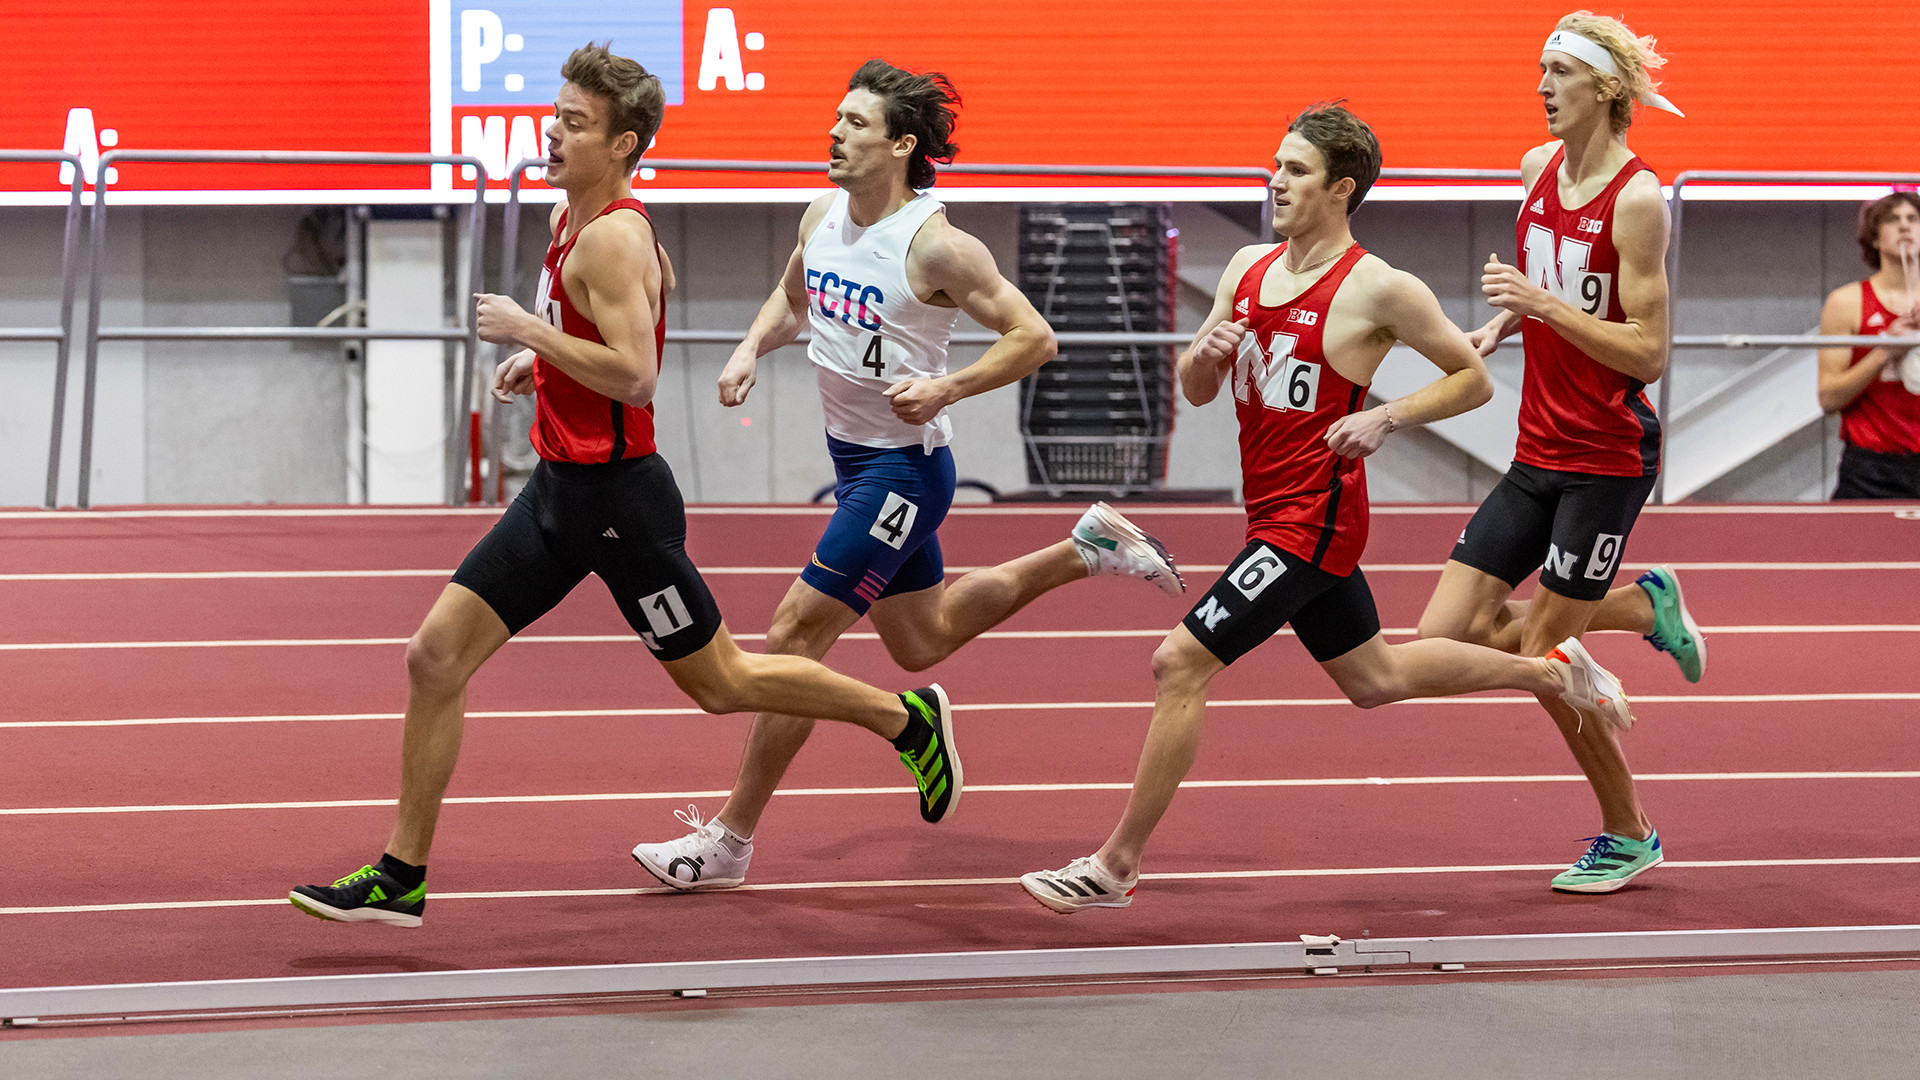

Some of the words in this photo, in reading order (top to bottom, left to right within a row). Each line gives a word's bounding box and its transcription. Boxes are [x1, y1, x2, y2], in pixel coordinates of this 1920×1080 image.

[460, 9, 525, 93] P:
[698, 7, 766, 92] A:
[59, 107, 119, 186] A:
[805, 268, 885, 332] FCTC
[1581, 274, 1603, 316] 9
[862, 335, 886, 378] 4
[1288, 364, 1312, 408] 6
[880, 502, 904, 543] 4
[1237, 555, 1279, 591] 6
[1544, 542, 1579, 581] N
[1592, 537, 1617, 577] 9
[652, 593, 681, 630] 1
[1194, 594, 1232, 633] N
